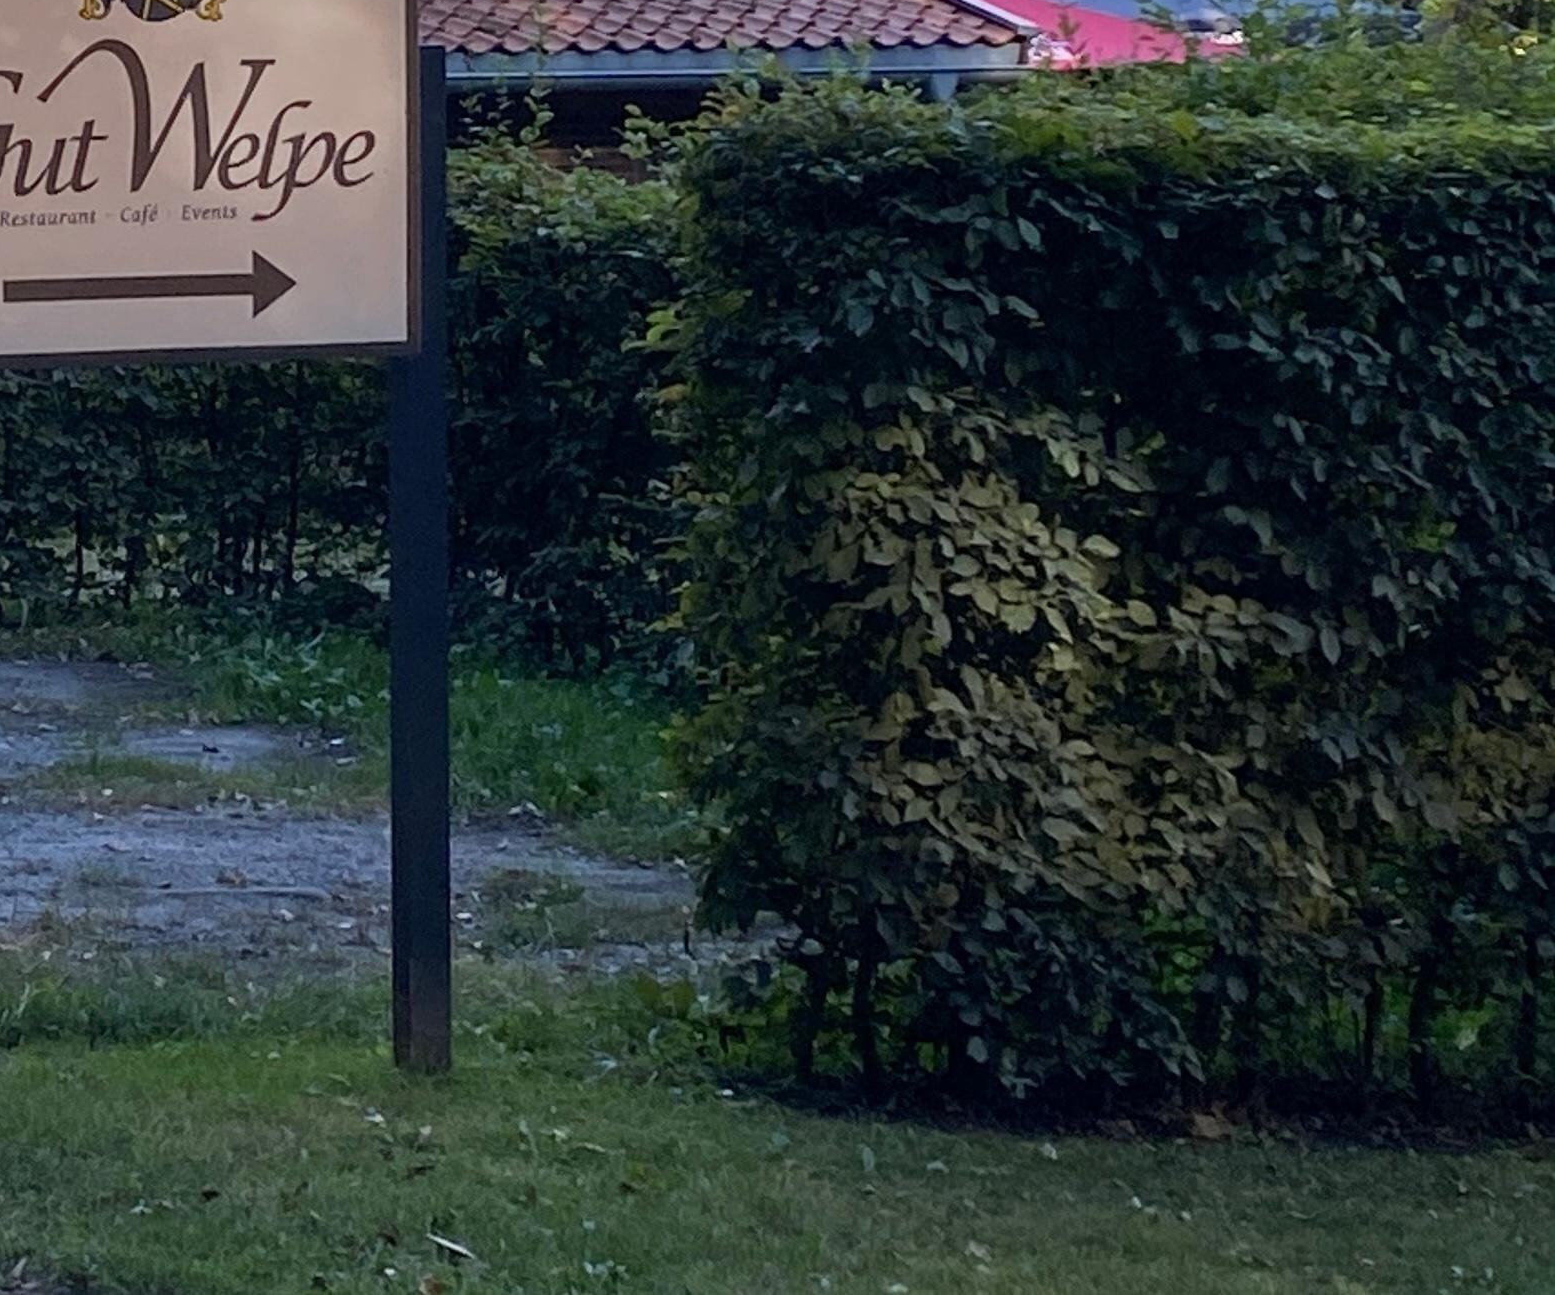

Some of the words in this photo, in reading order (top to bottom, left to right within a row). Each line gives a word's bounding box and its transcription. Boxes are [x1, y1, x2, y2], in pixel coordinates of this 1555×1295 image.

[38, 39, 375, 221] Welpe
[0, 208, 97, 228] Restaurant
[119, 204, 159, 225] Café
[181, 204, 238, 222] Events
